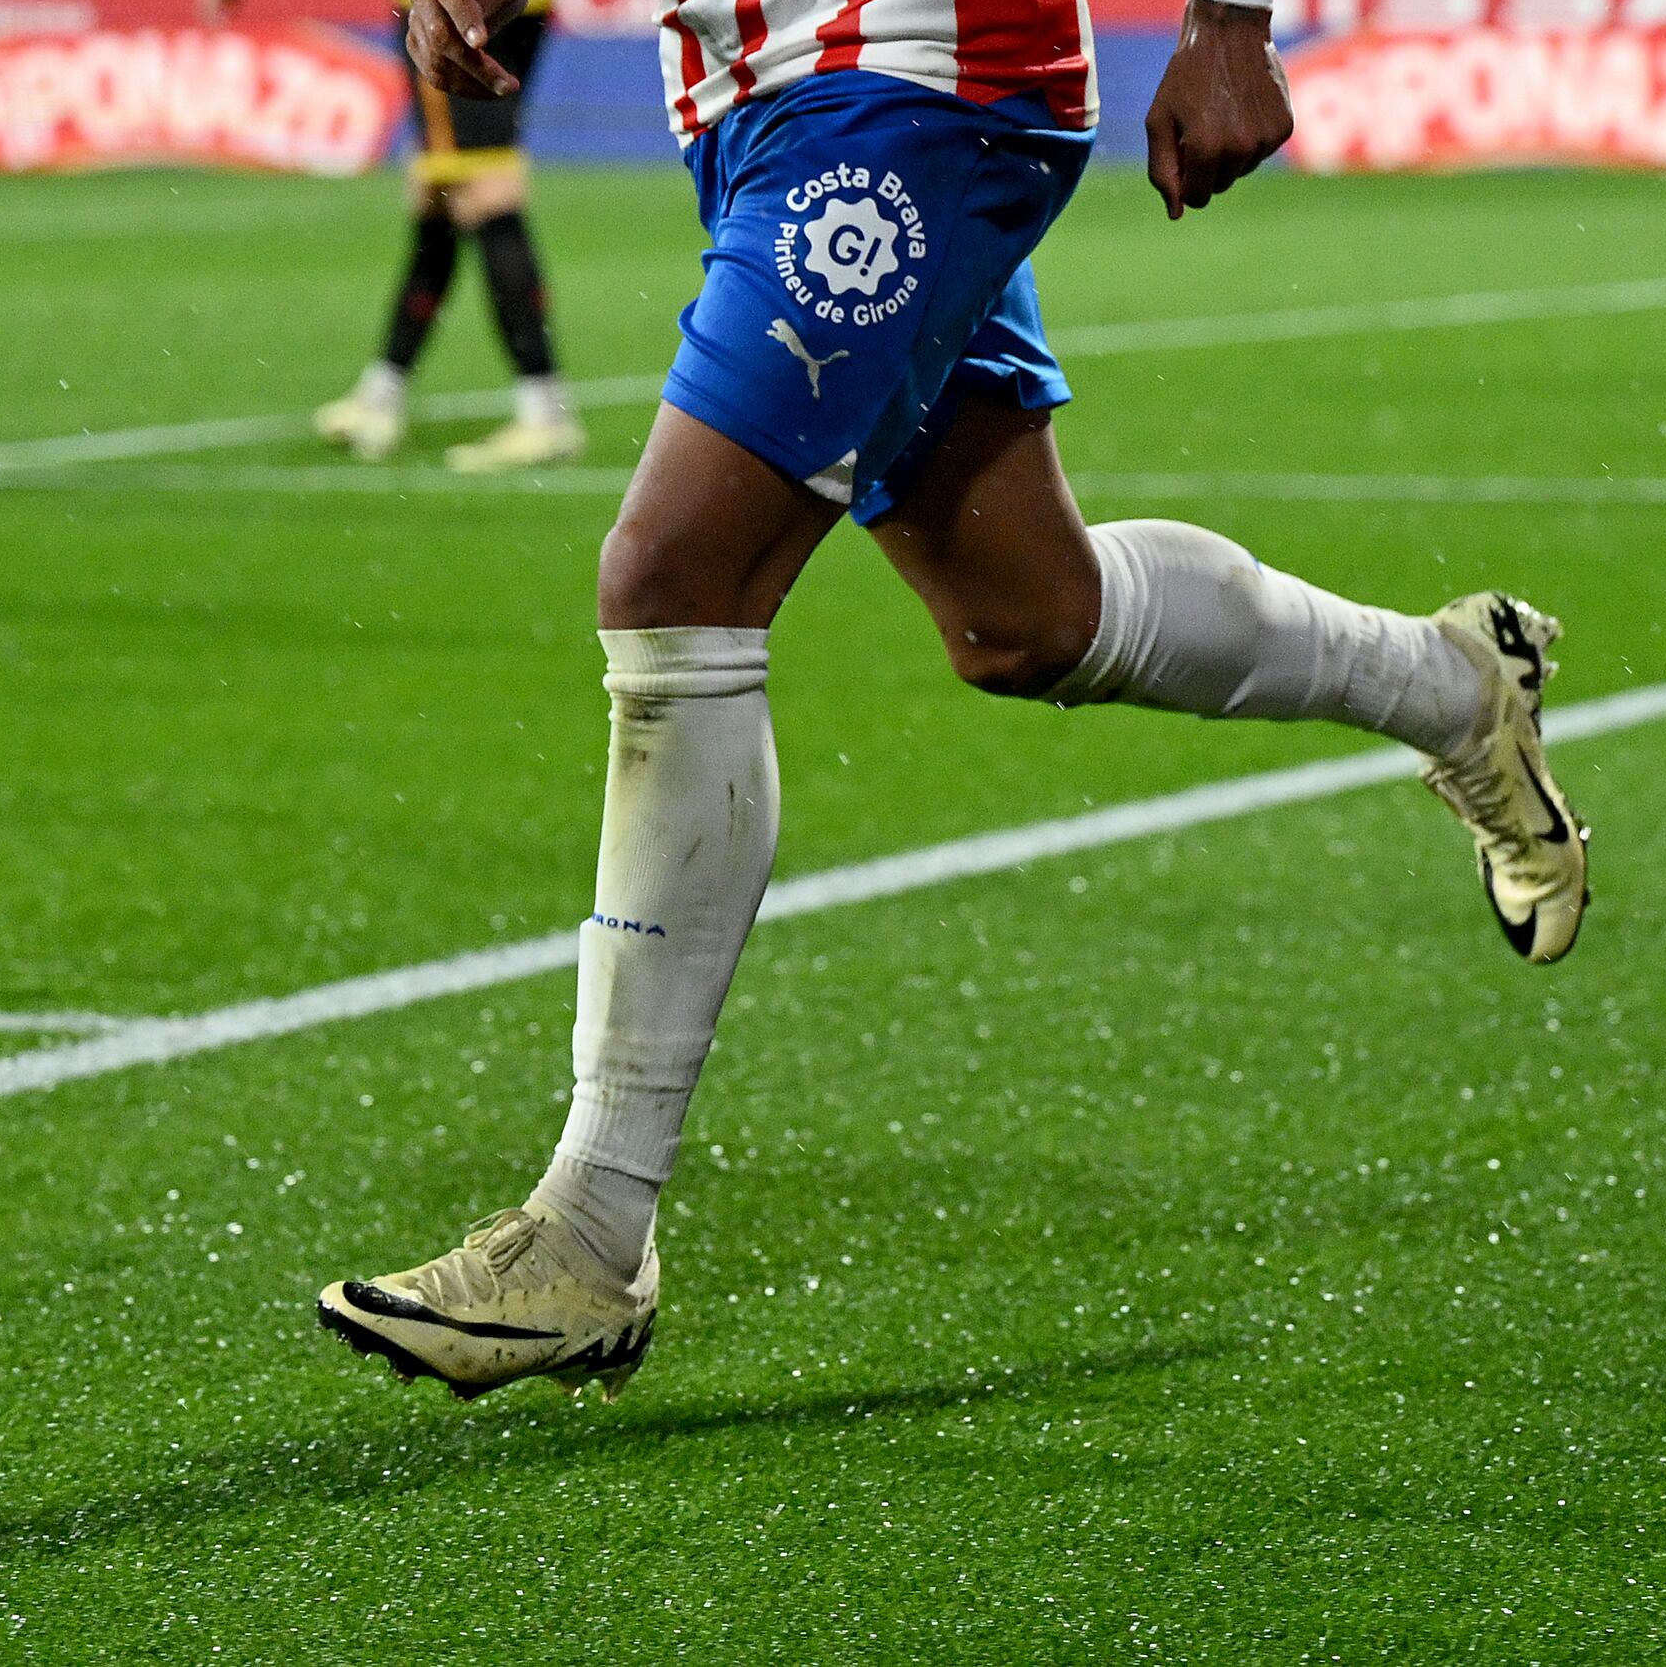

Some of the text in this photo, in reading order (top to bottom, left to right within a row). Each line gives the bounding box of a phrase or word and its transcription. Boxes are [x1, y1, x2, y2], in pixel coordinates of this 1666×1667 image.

[785, 161, 926, 259] Costa Brava
[774, 222, 919, 326] Pirineu de Girona
